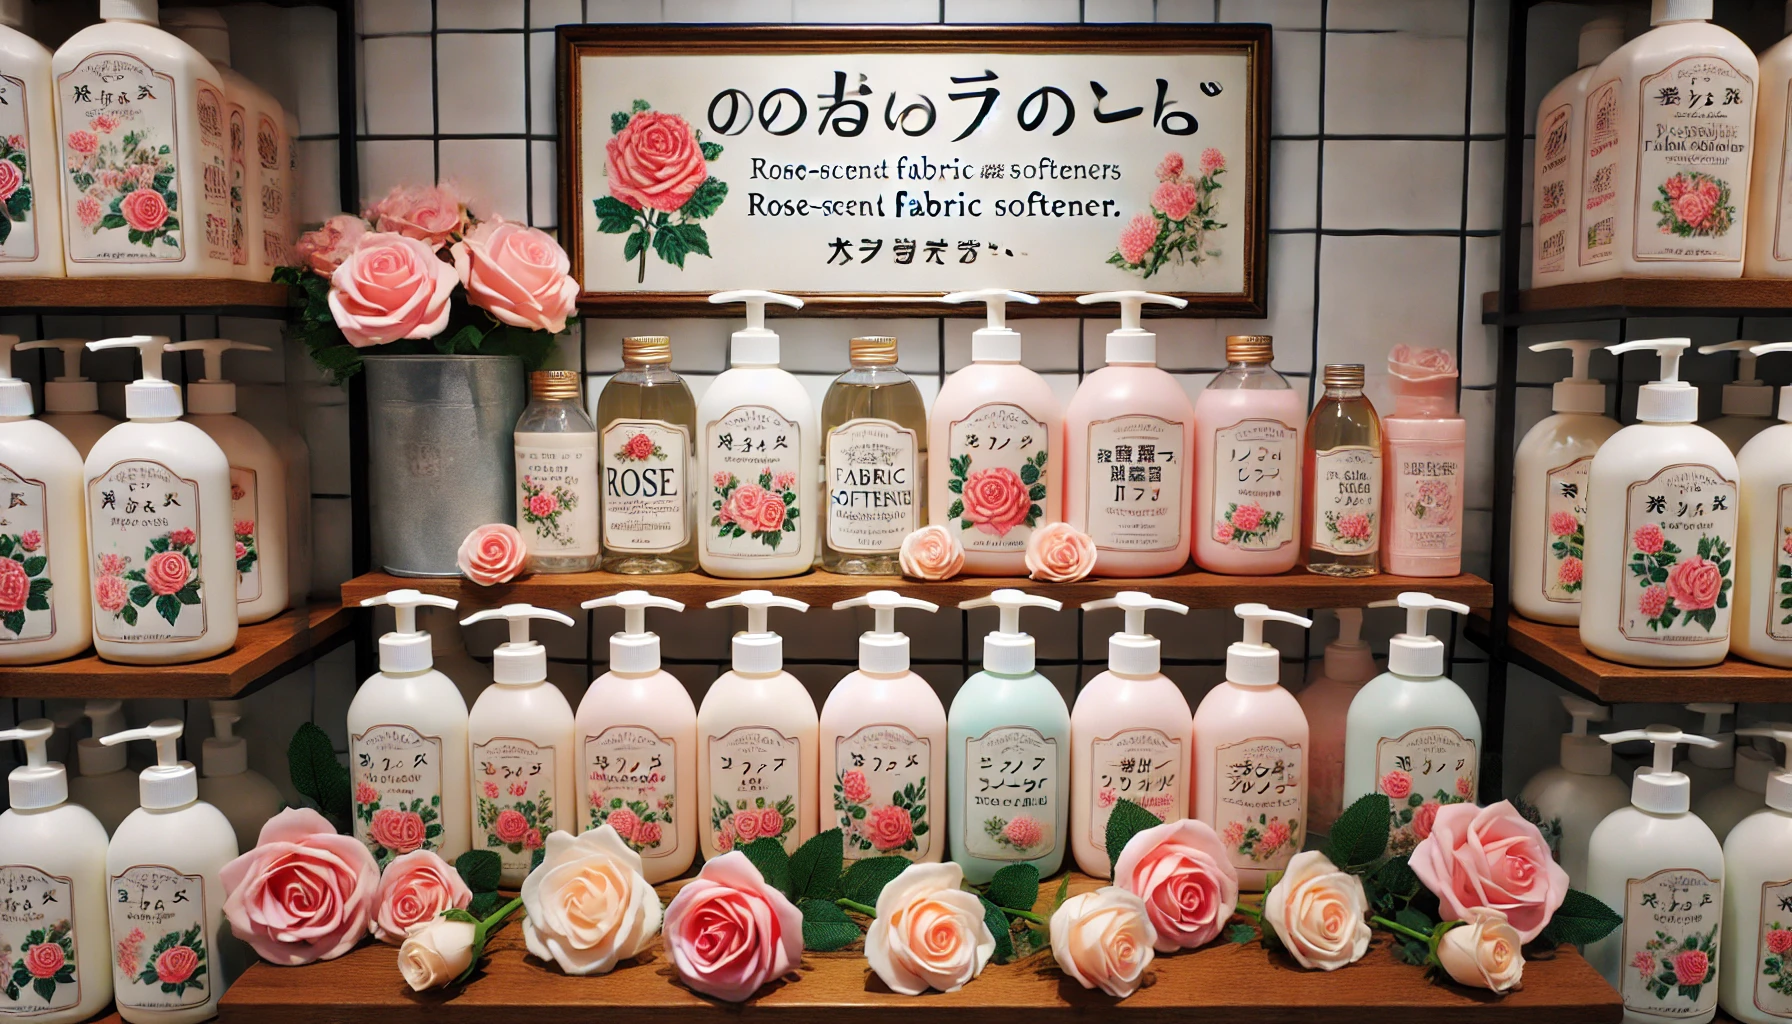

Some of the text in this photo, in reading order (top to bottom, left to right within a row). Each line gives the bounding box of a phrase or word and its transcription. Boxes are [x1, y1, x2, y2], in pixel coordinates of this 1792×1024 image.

[1009, 156, 1122, 180] softeners
[748, 190, 1121, 218] Rose-scent fabric softener.
[606, 467, 678, 497] ROSE
[836, 467, 906, 486] FABRIC
